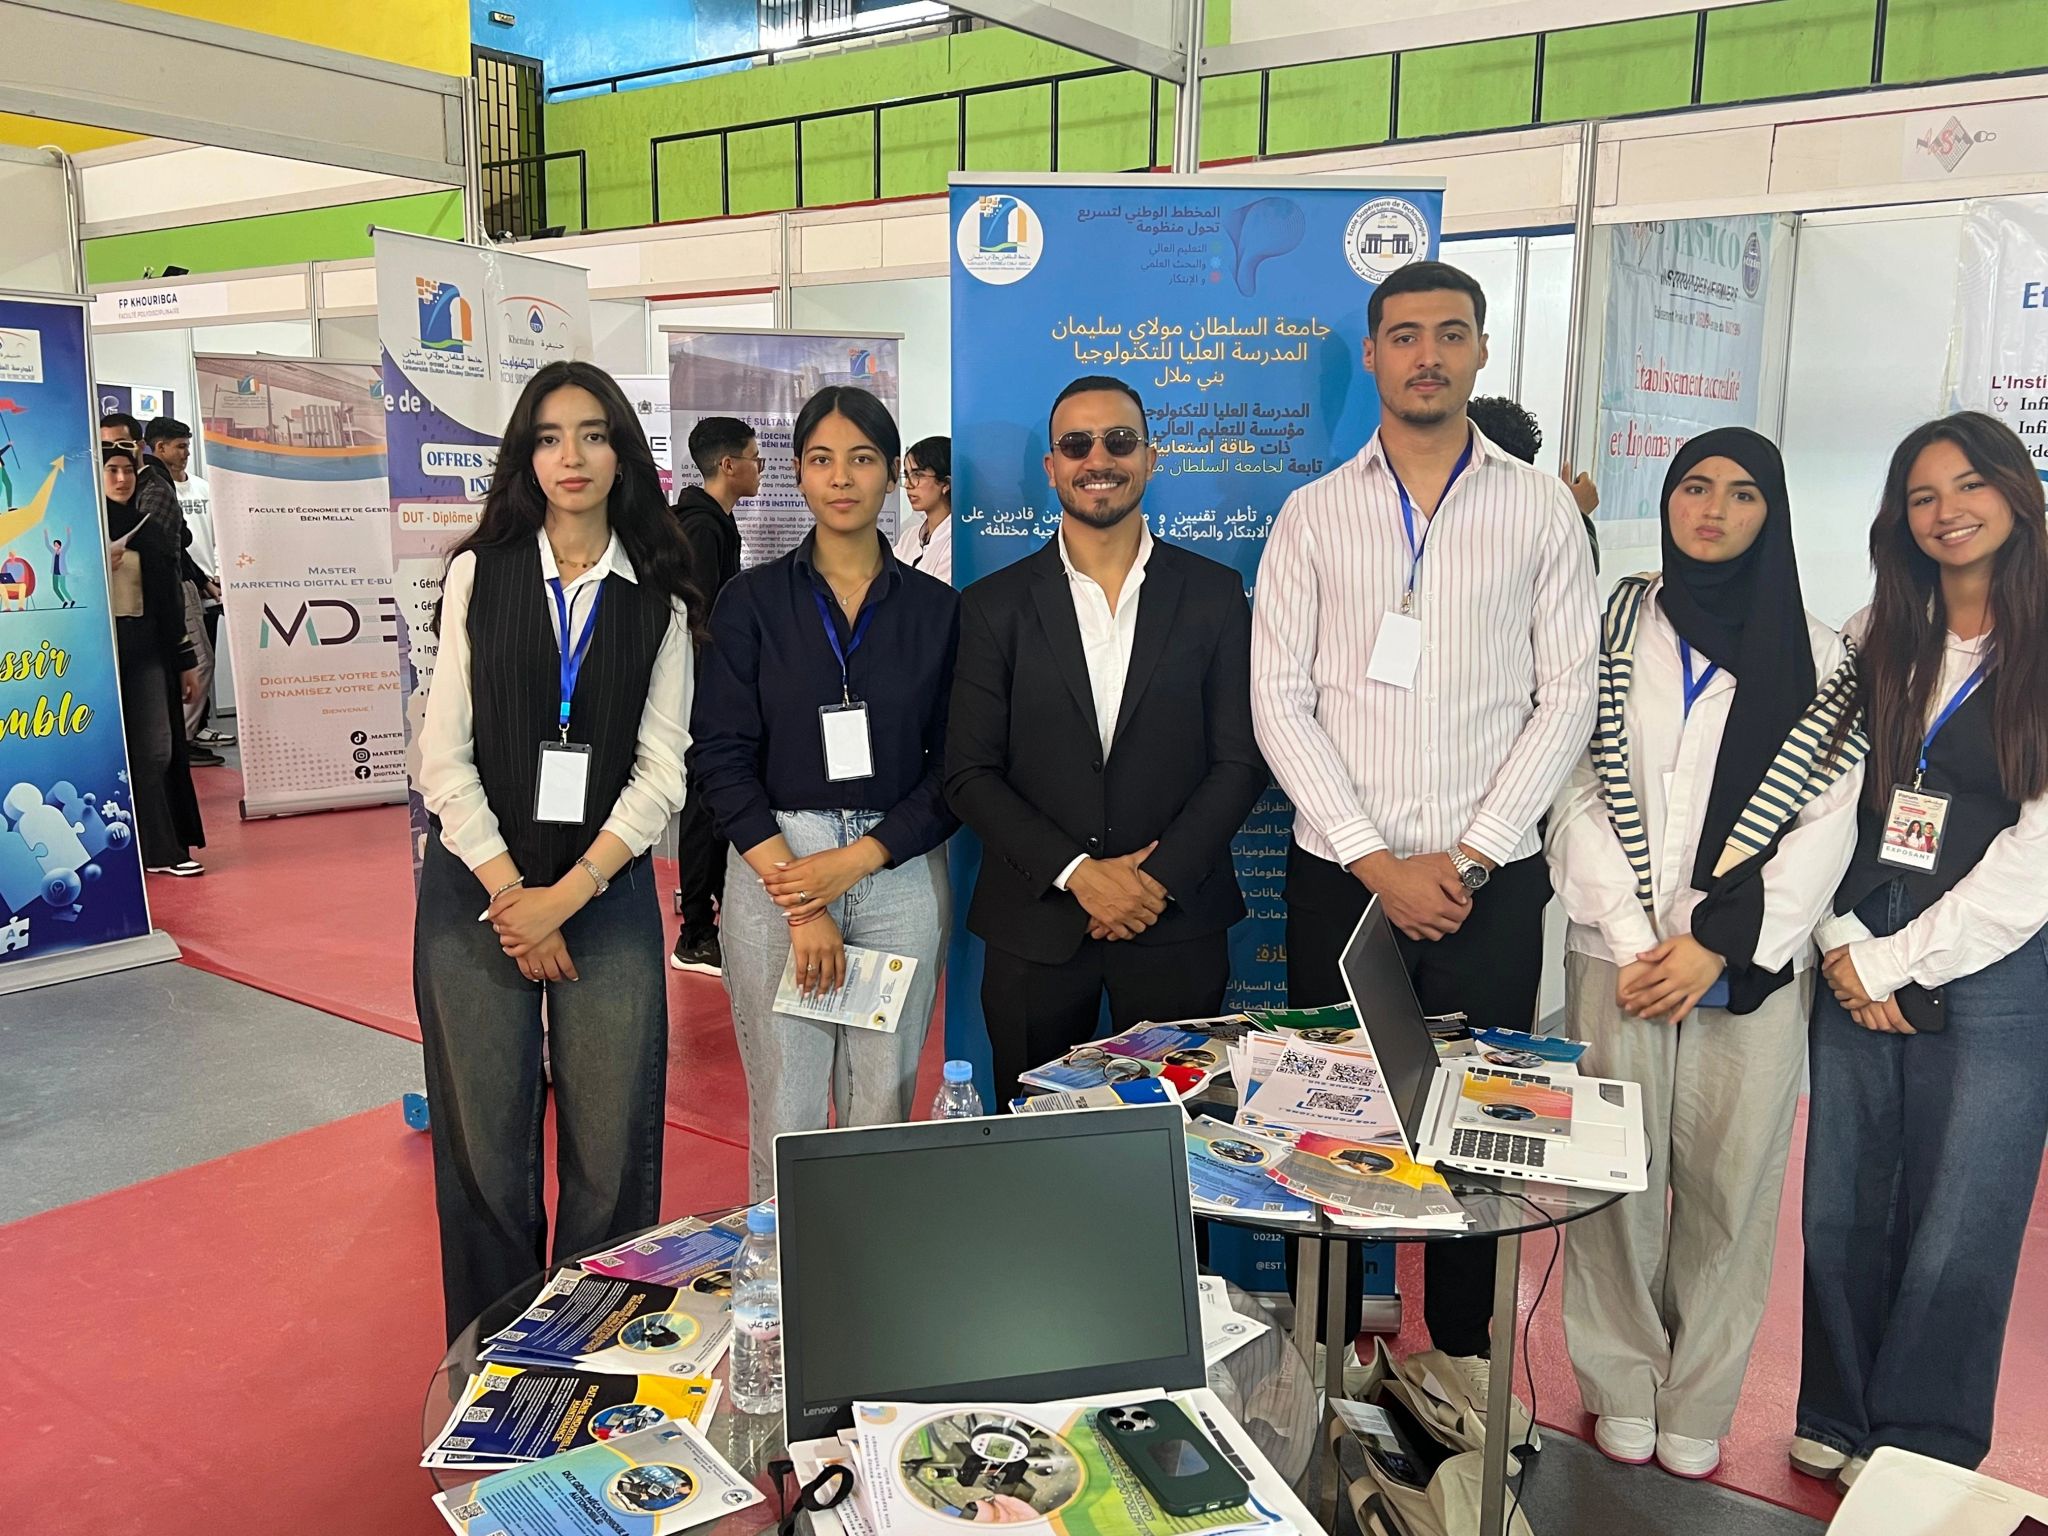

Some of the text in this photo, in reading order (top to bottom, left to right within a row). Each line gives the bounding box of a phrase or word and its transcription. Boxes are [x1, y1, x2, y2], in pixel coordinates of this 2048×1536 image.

[1077, 206, 1220, 225] المخطط الوطني لتسريع
[1137, 219, 1219, 236] تحول منظومة
[119, 294, 178, 308] FP KHOURIBGA
[1051, 316, 1331, 345] جامعة السلطان مولاي سليمان
[1074, 341, 1308, 365] المدرسة العليا للتكنولوجيا
[1154, 367, 1225, 391] بني ملال
[1634, 345, 1740, 401] Établissement accrédité
[399, 389, 421, 412] de
[1213, 403, 1310, 421] المدرسة العليا
[754, 417, 790, 426] SULTAN
[1153, 421, 1304, 442] مؤسسة للتعليم العالي
[1219, 439, 1256, 455] طاقة
[1260, 440, 1291, 455] ذات
[1610, 431, 1622, 456] et
[427, 451, 483, 467] OFFRES
[1169, 457, 1229, 476] السلطان
[1287, 458, 1323, 475] تابعة
[403, 511, 424, 523] DUT
[433, 511, 473, 526] Diplôme
[961, 506, 985, 523] على
[992, 506, 1034, 523] قادرين
[1158, 513, 1166, 525] و
[1174, 508, 1217, 525] تقنيين
[1223, 505, 1257, 525] تأطير
[1266, 514, 1273, 525] و
[1168, 524, 1224, 541] والمواكبة
[230, 581, 300, 589] MARKETING
[304, 579, 347, 587] DIGITAL
[260, 674, 335, 686] DIGITALISEZ
[339, 671, 378, 681] VOTRE
[261, 687, 332, 699] DYNAMISEZ
[334, 685, 374, 694] VOTRE
[321, 706, 369, 715] BIENVENUE
[1886, 846, 1930, 860] EXPOSANT
[1256, 1262, 1281, 1271] @EST
[587, 1385, 599, 1398] DUT
[579, 1398, 593, 1415] GÉNIE
[803, 1405, 838, 1417] Lenovo
[563, 1470, 626, 1535] DUT GÉNIE MÉCATRONIQUE
